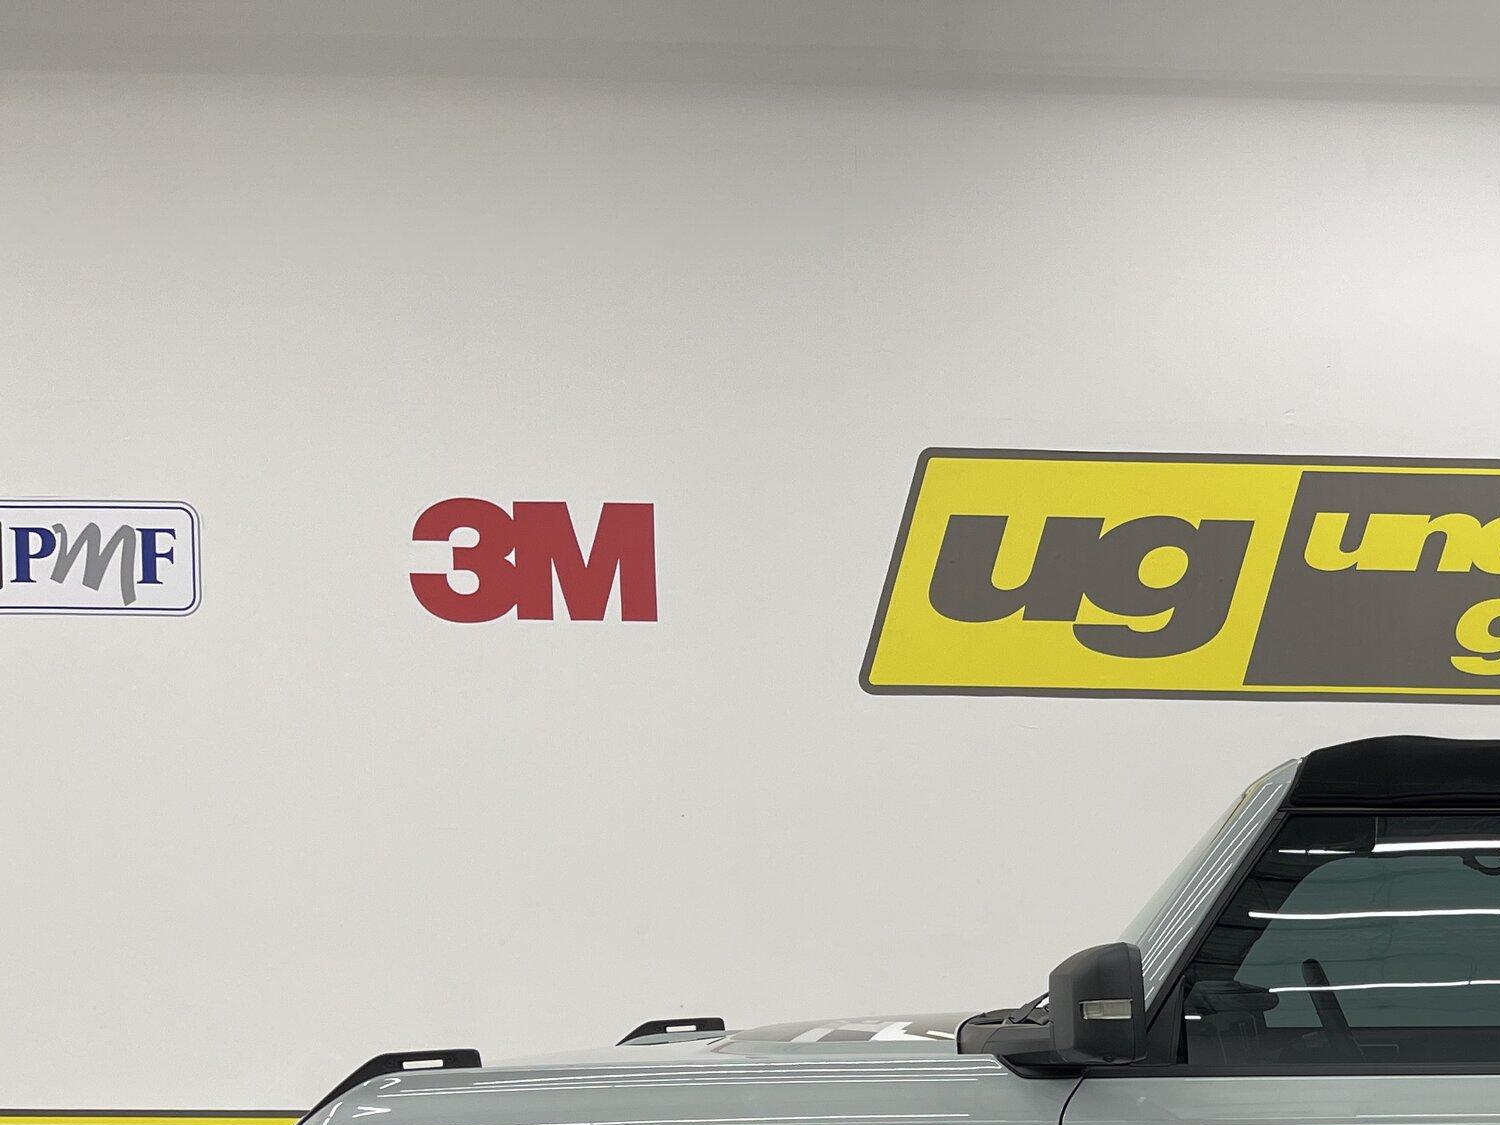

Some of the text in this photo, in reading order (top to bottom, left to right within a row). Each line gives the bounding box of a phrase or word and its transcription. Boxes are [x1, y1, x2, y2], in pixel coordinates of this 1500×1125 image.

[9, 522, 176, 607] PMF
[410, 497, 657, 623] 3M
[929, 515, 1255, 659] ug
